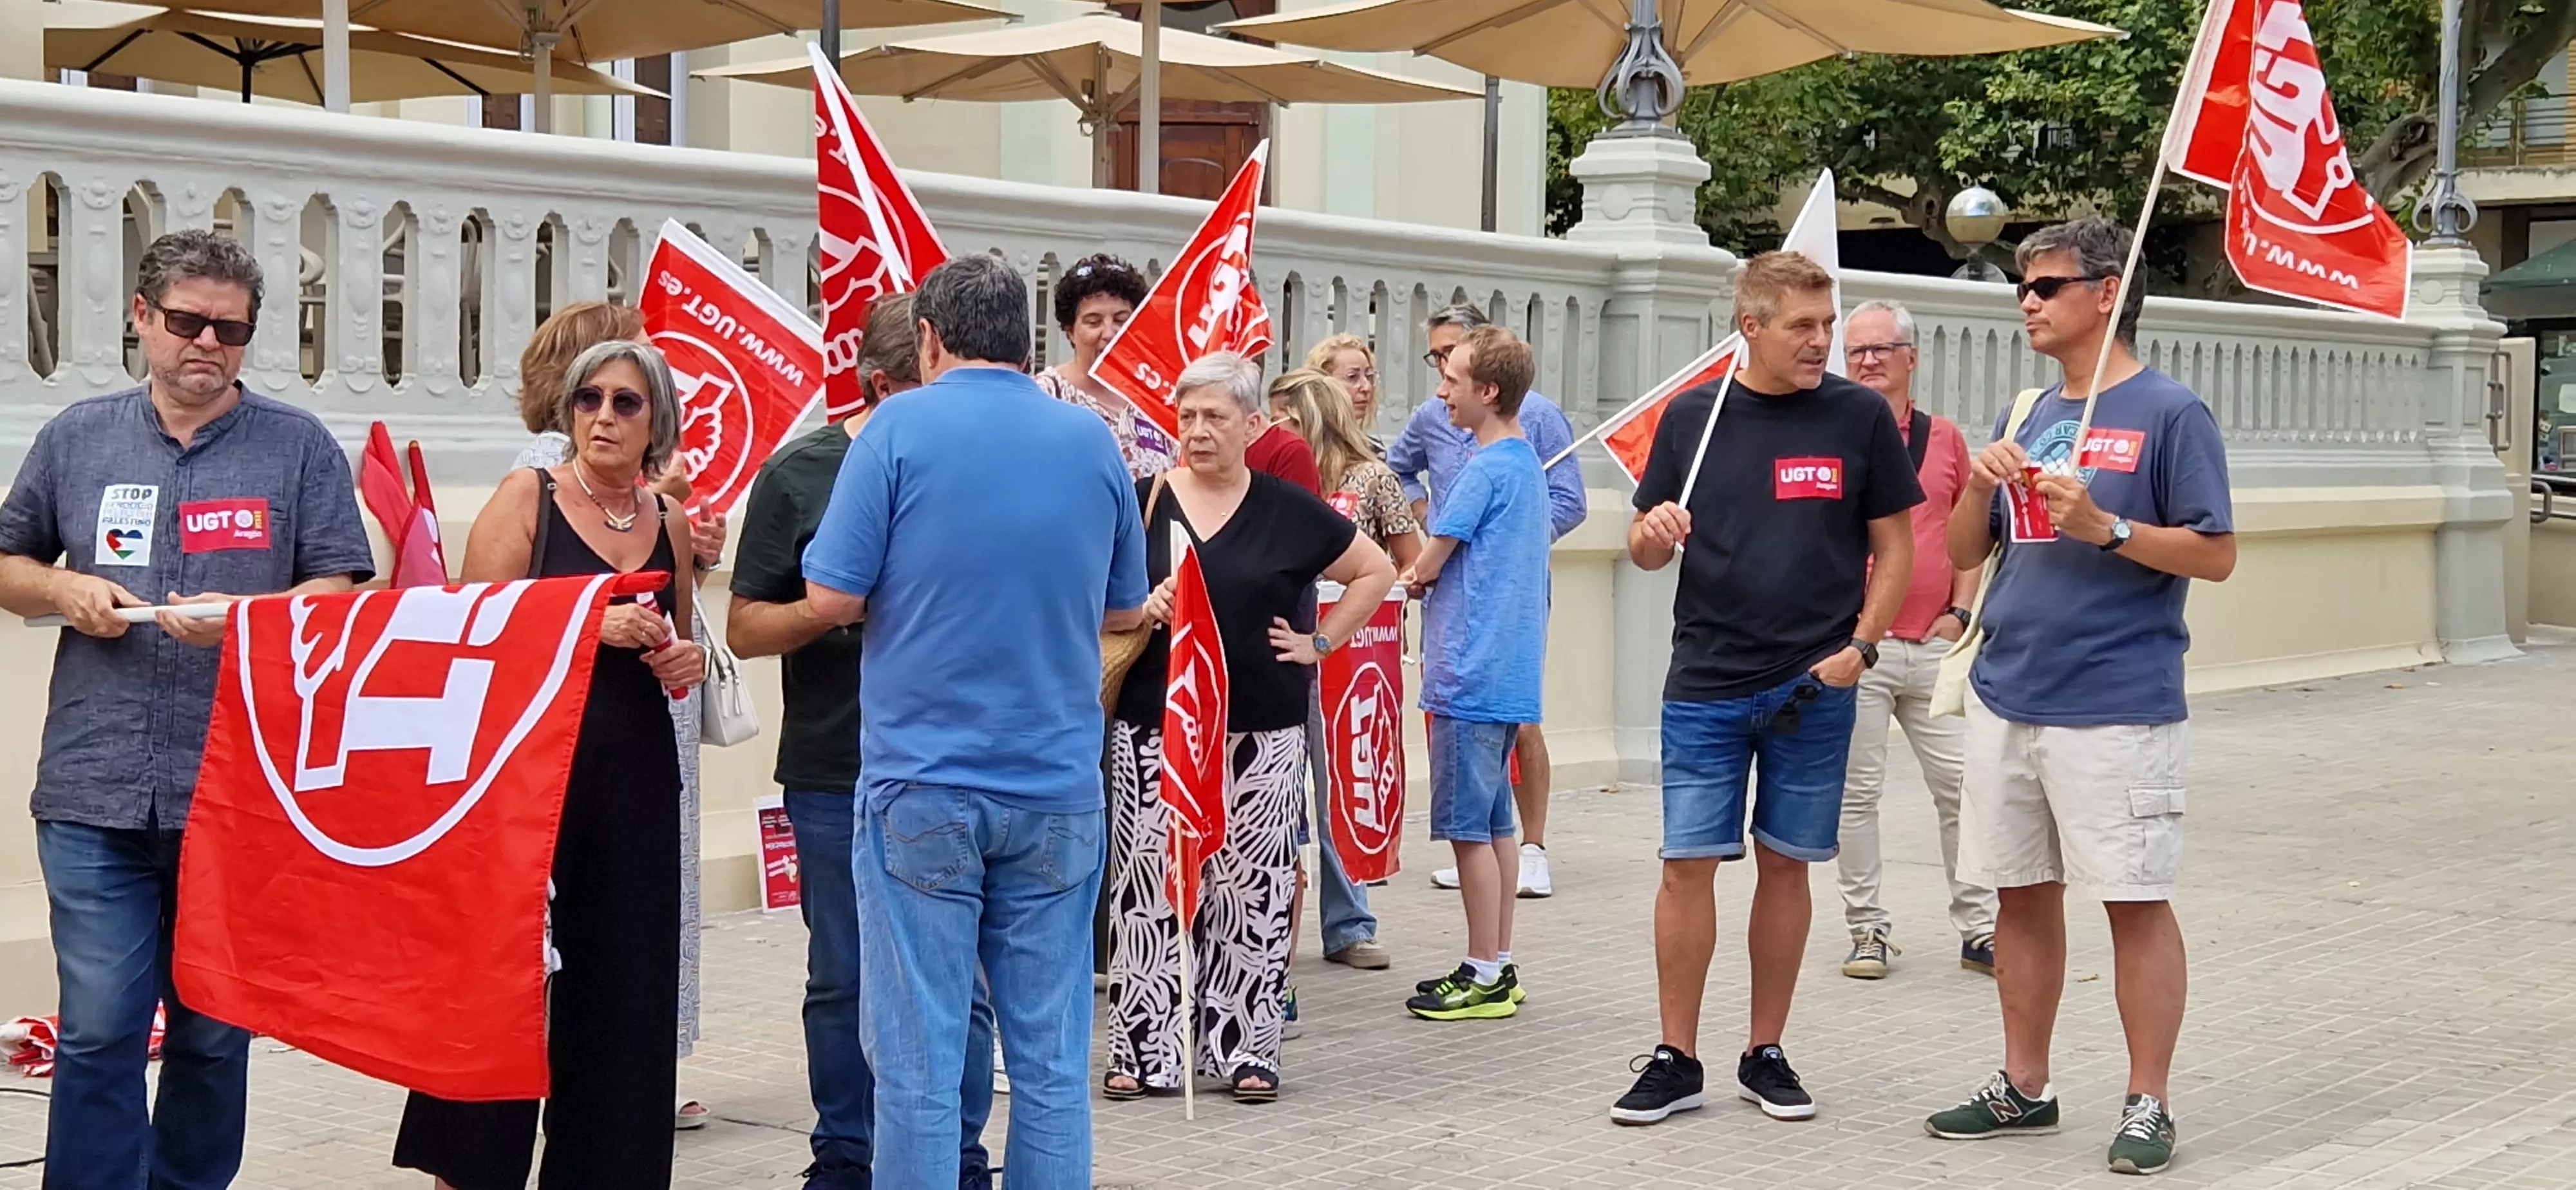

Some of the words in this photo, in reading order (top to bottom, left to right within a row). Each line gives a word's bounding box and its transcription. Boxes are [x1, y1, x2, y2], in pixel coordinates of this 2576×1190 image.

[657, 269, 804, 387] www.UGT.es
[1779, 466, 1816, 483] UGT
[111, 488, 153, 500] STOP
[186, 510, 233, 533] UGT
[1350, 692, 1378, 829] UGT
